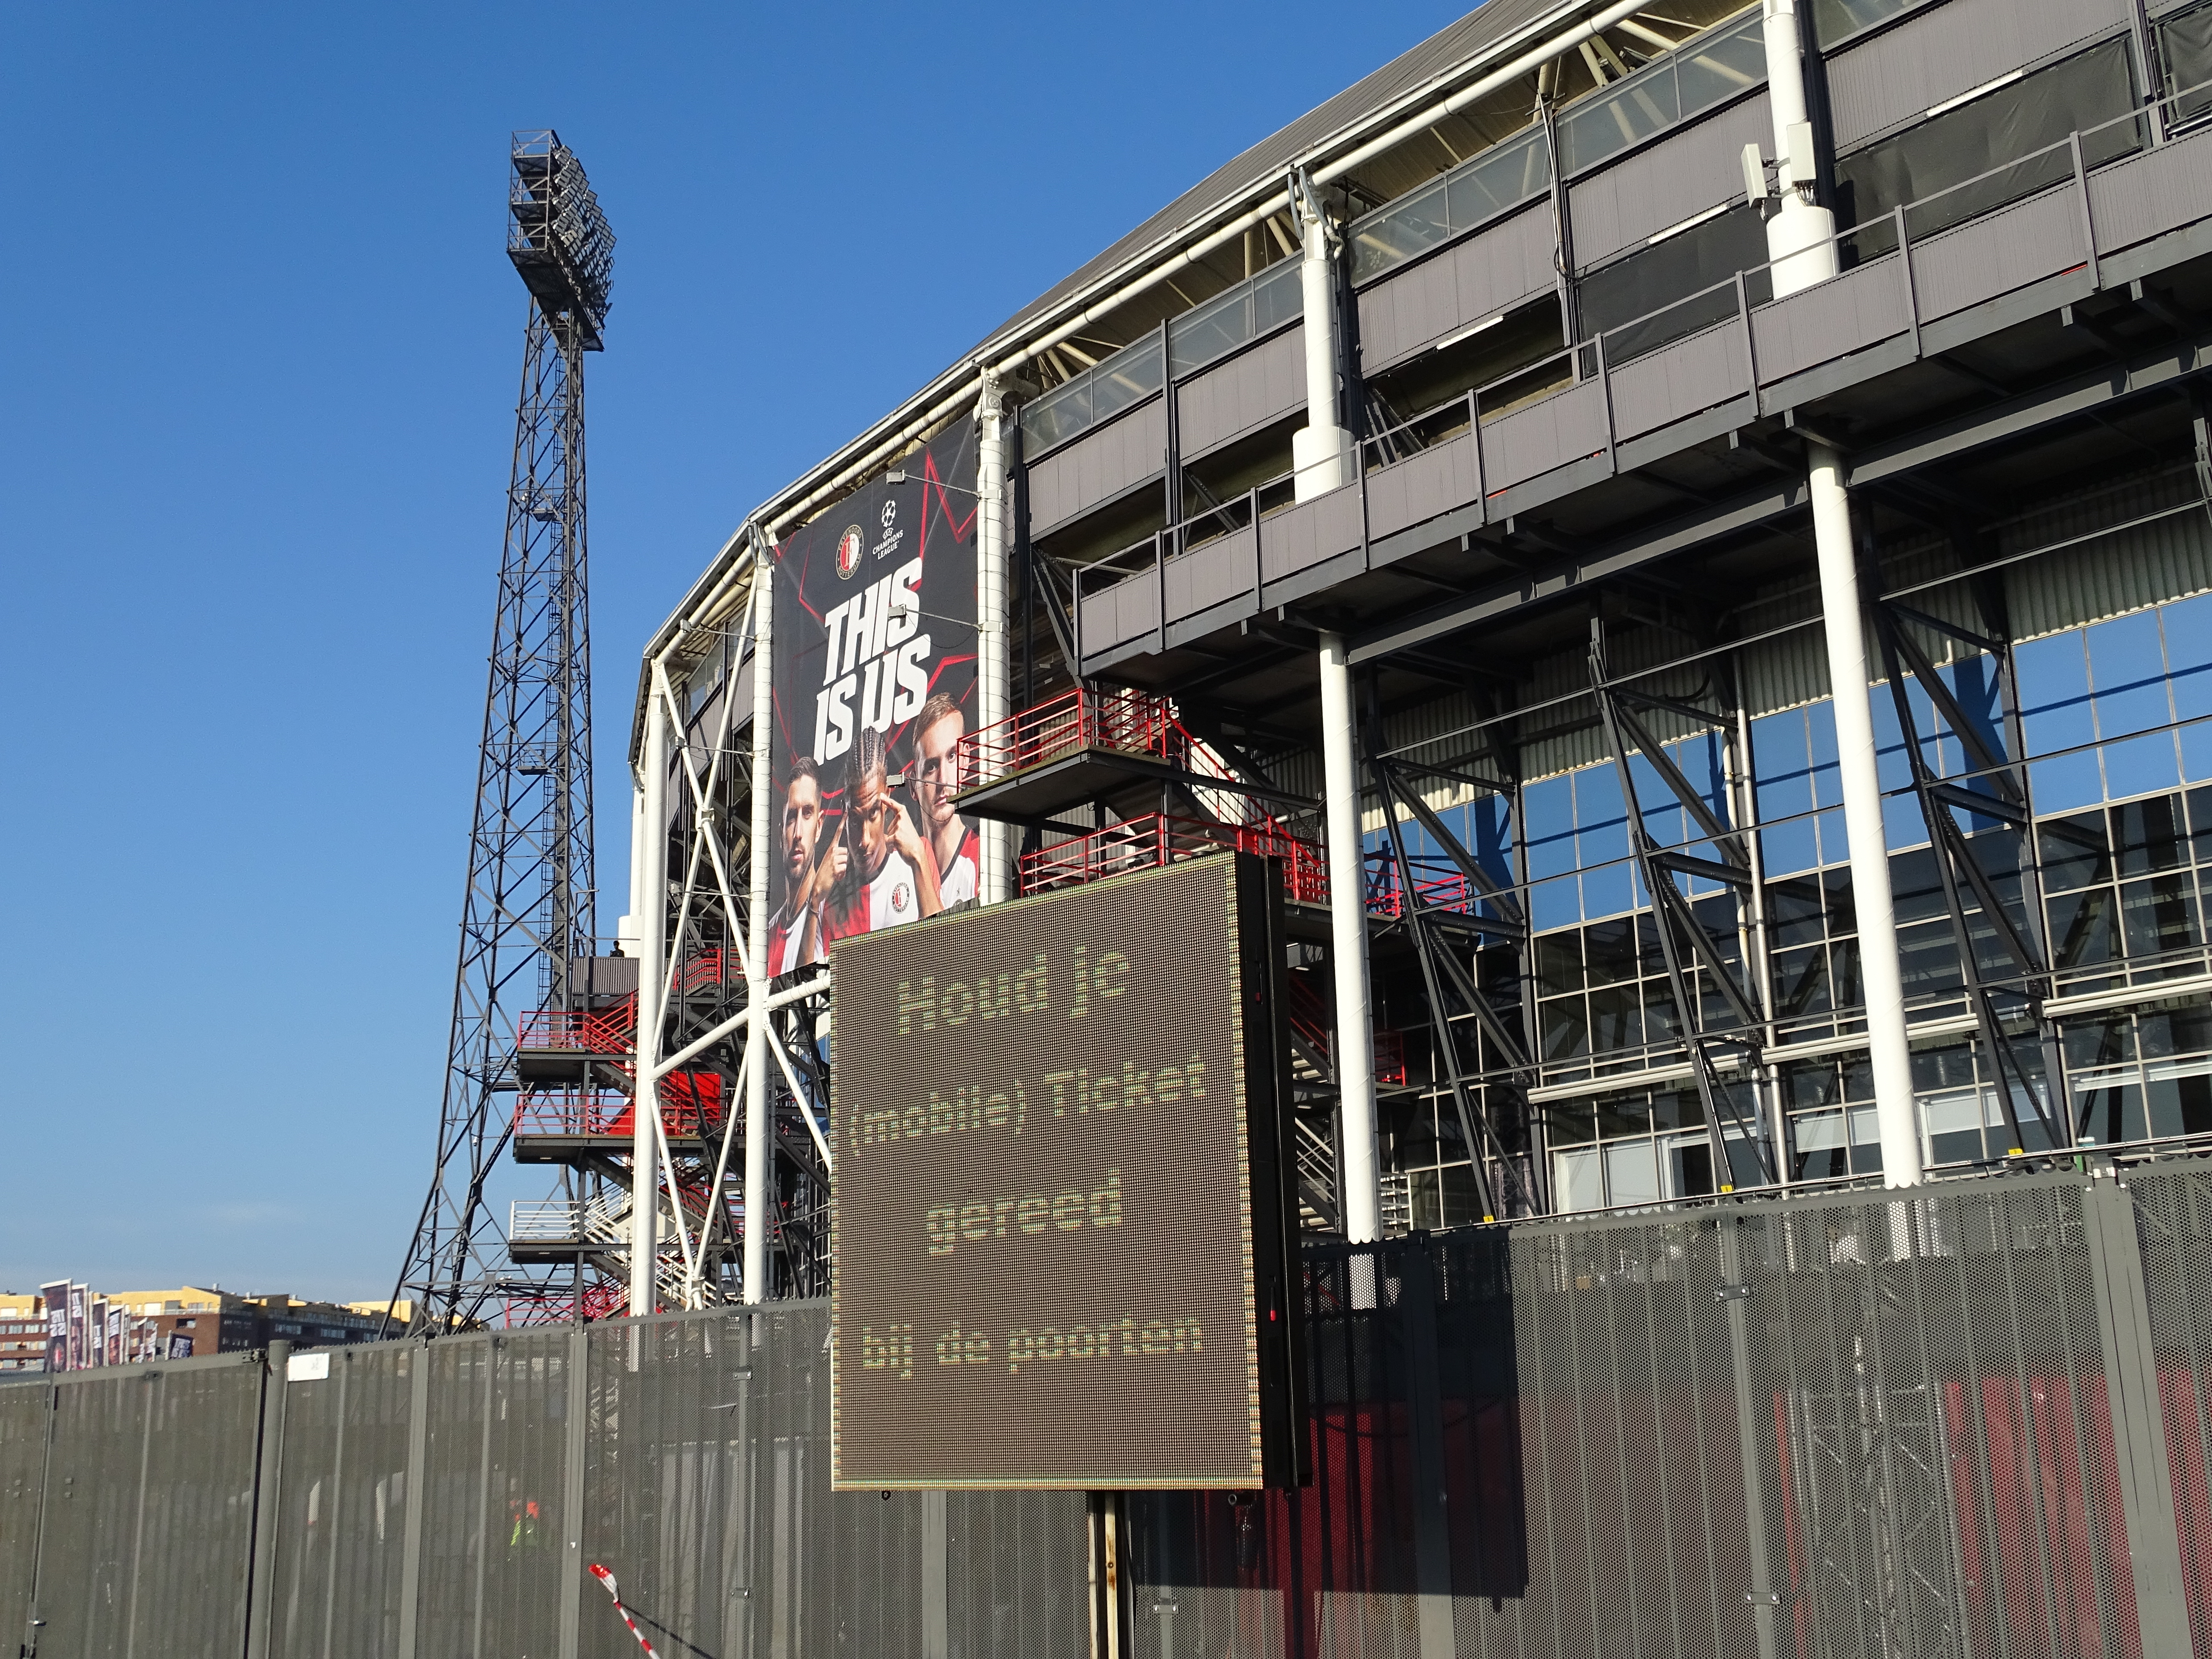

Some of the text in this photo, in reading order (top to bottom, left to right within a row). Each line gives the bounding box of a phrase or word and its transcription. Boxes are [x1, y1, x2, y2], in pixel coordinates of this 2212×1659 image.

[838, 553, 862, 577] ROTTERDAM
[872, 530, 903, 555] CHAMPIONS
[878, 541, 898, 560] LEAGUE
[823, 557, 922, 686] THIS
[813, 633, 931, 766] IS US
[896, 945, 1130, 1036] Houd je
[849, 1051, 1206, 1157] (mobile) Ticket
[926, 1167, 1123, 1255] gereed
[862, 1313, 1203, 1380] bij de poorten
